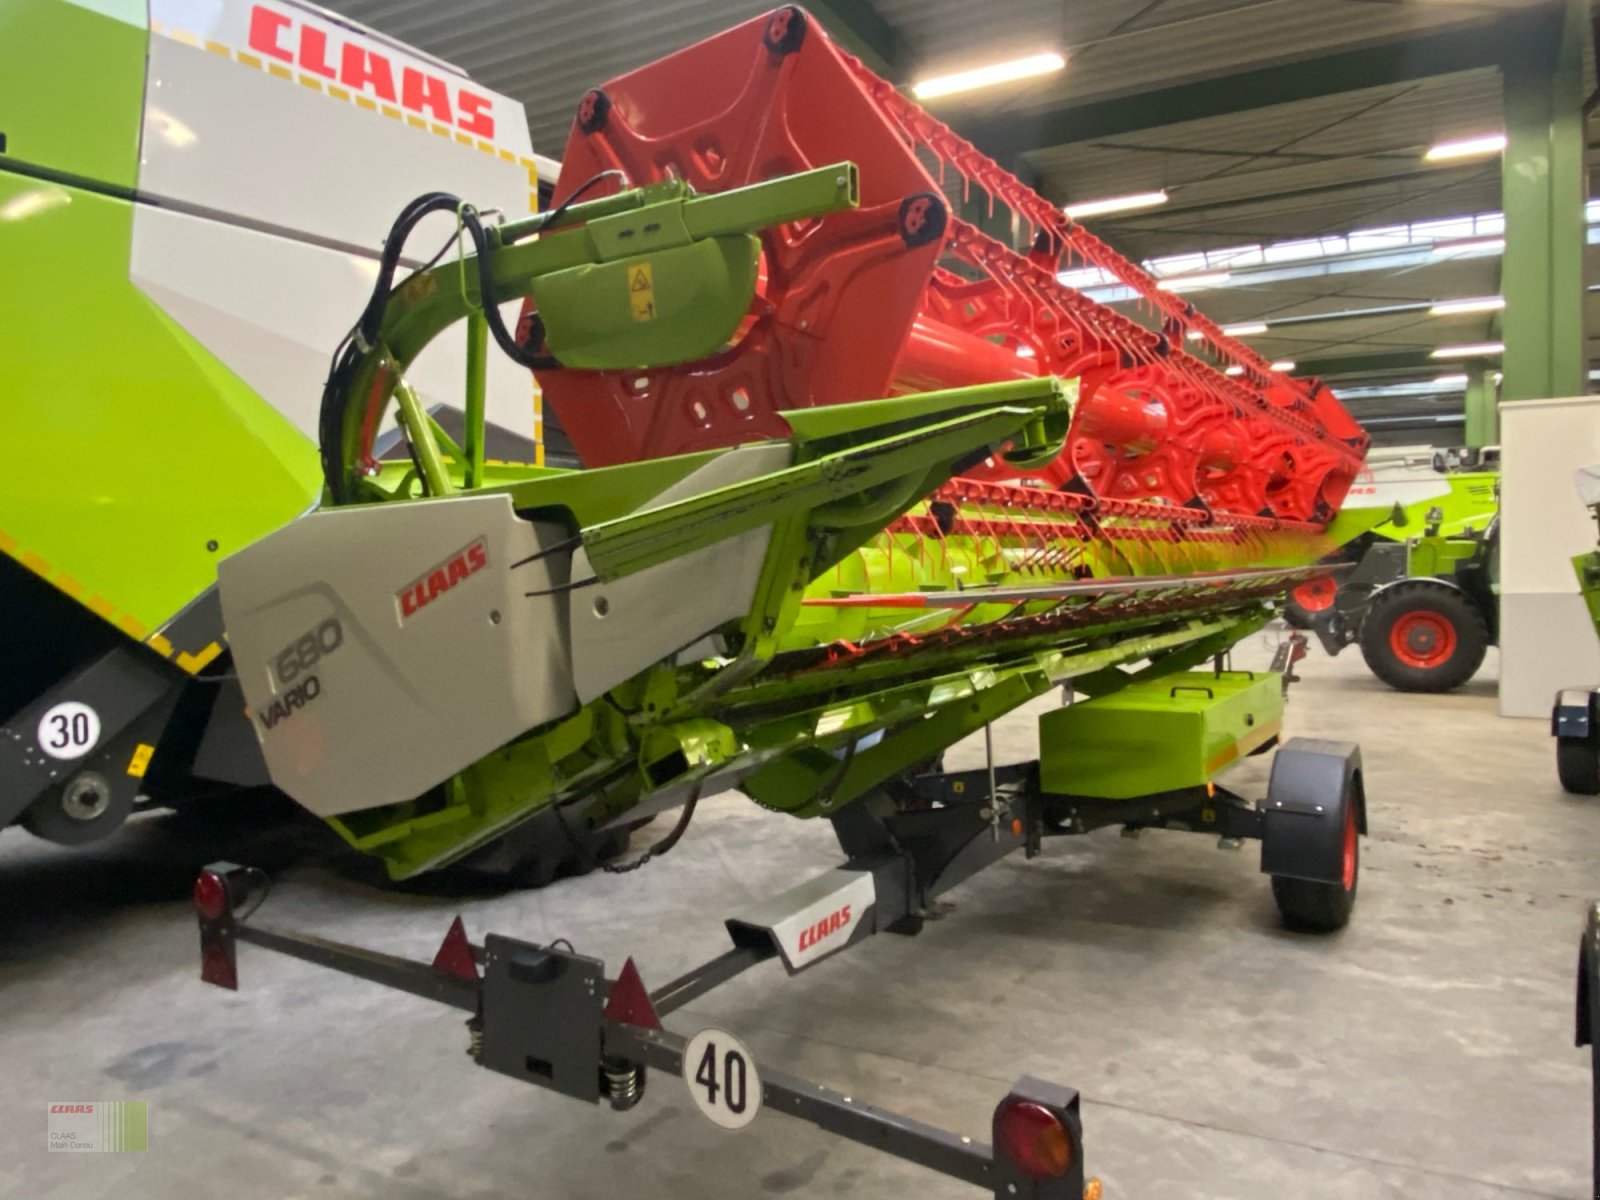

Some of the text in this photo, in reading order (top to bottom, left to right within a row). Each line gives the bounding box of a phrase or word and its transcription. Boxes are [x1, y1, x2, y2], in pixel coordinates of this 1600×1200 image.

[249, 5, 494, 139] CLAAS
[400, 542, 487, 618] CLAAS
[276, 619, 343, 684] 680
[50, 713, 89, 748] 30
[260, 676, 320, 730] VARIO
[799, 904, 851, 952] CLAAS
[695, 1042, 746, 1114] 40
